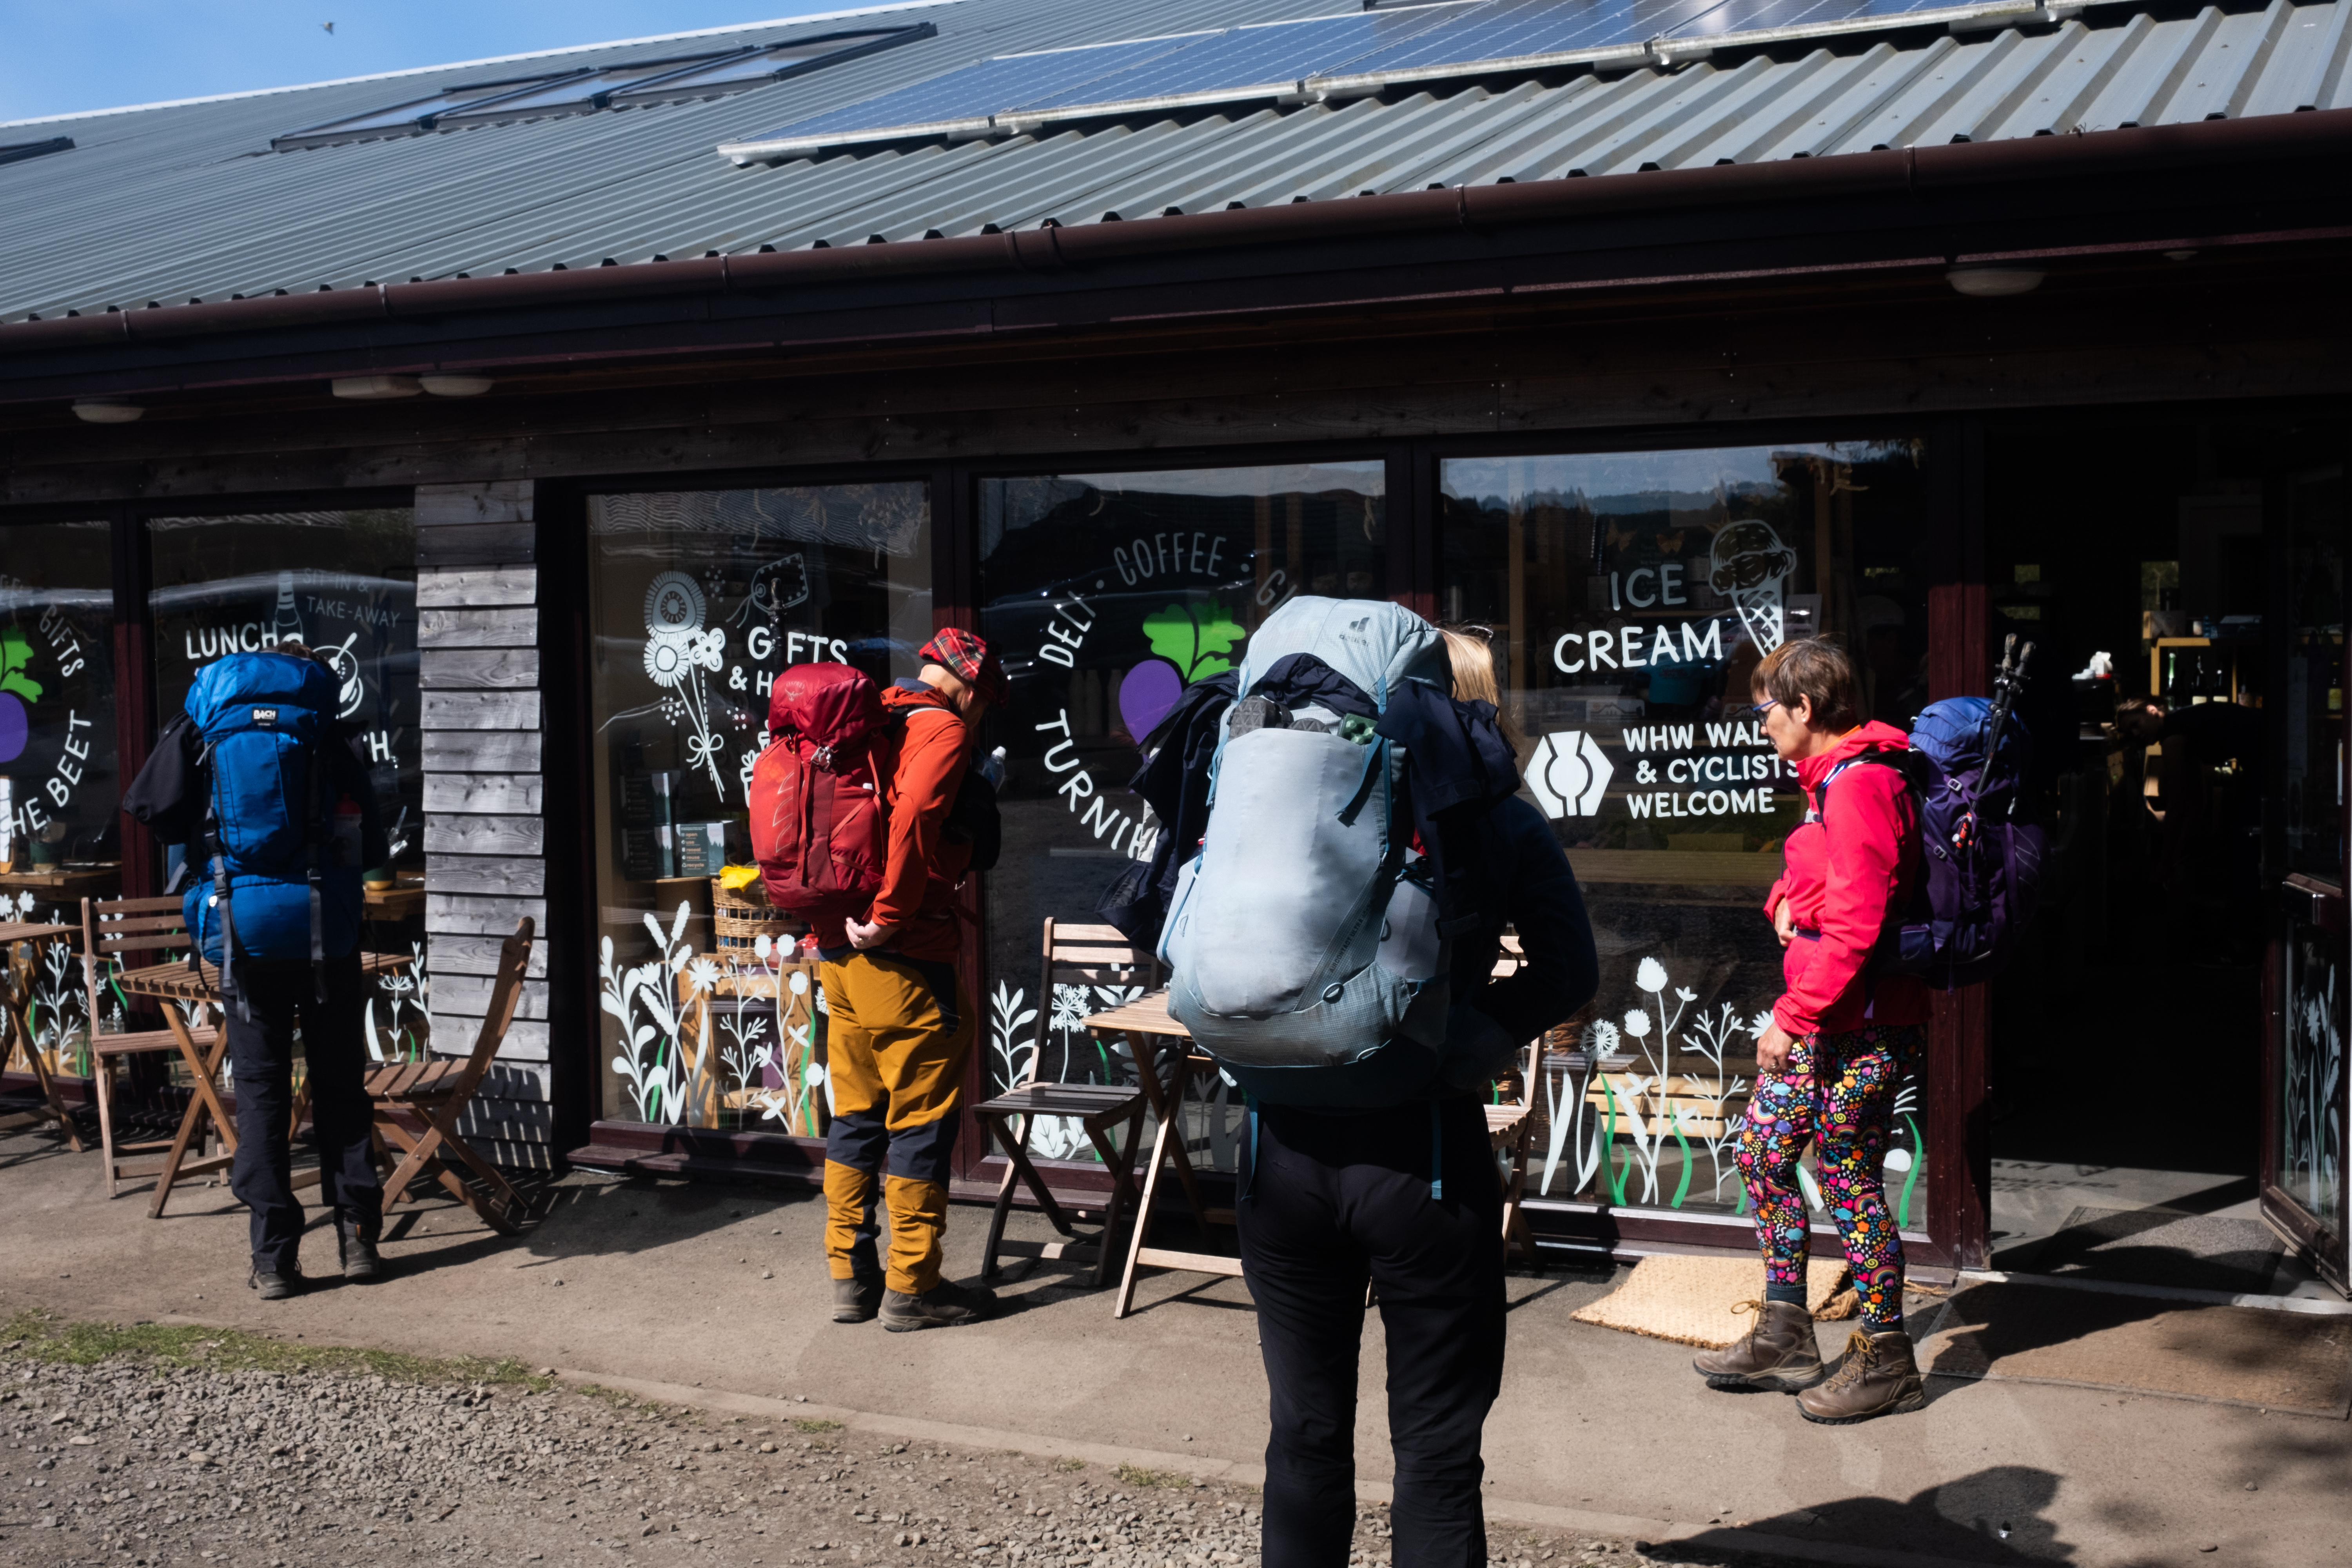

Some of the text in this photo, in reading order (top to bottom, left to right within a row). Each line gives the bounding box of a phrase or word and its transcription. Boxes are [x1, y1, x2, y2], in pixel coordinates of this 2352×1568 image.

[1114, 533, 1227, 586] COFFEE
[303, 568, 369, 593] SIT IN &
[1610, 564, 1687, 611] ICE
[307, 596, 401, 628] TAKE-AWAY
[1039, 590, 1096, 668] DELI
[40, 604, 84, 677] GIFTS
[186, 621, 277, 659] LUNCH
[748, 626, 848, 665] GFTS
[1554, 619, 1722, 673] CREAM
[729, 666, 747, 691] &
[254, 710, 276, 719] BACH
[1623, 723, 1694, 753] WHW
[10, 709, 91, 838] HE BEET
[1636, 760, 1657, 784] &
[1627, 787, 1775, 819] WELCOME
[1329, 919, 1364, 973] AIRCONTACT ULTRA
